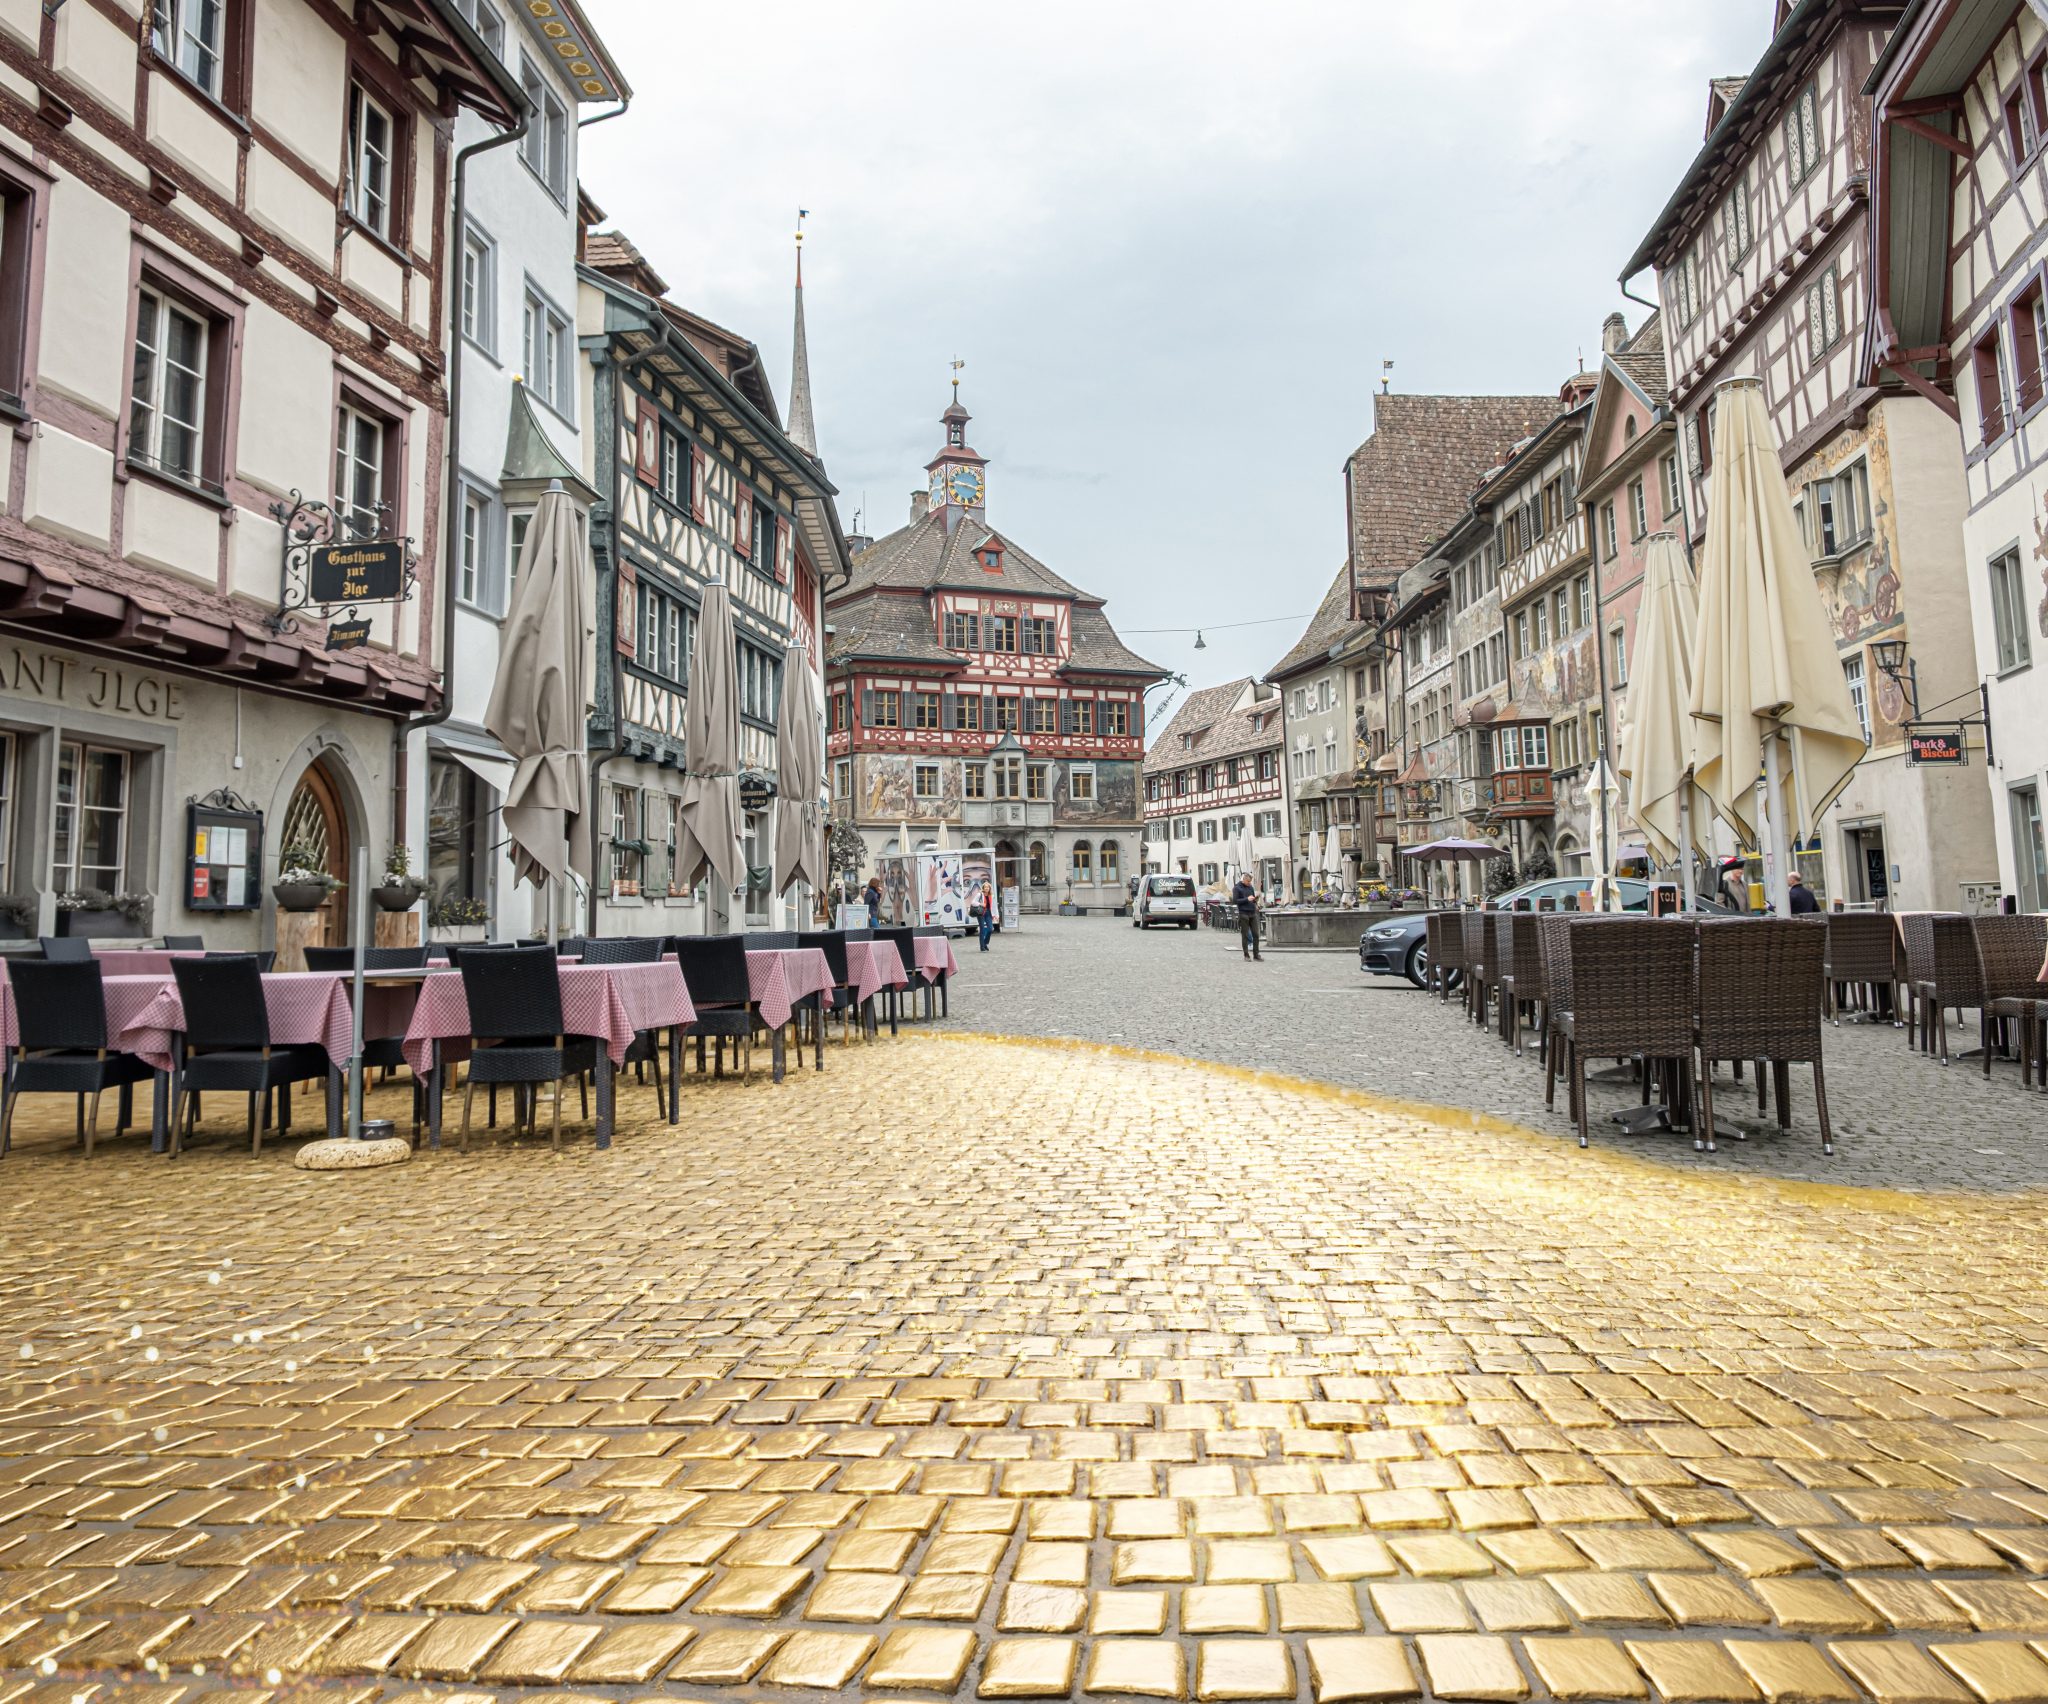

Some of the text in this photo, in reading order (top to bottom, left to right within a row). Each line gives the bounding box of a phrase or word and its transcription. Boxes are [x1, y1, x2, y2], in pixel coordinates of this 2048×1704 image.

[327, 550, 387, 566] Gasthaus
[346, 566, 366, 580] zur
[331, 629, 366, 641] Zimmer
[1921, 747, 1958, 758] Biscuit
